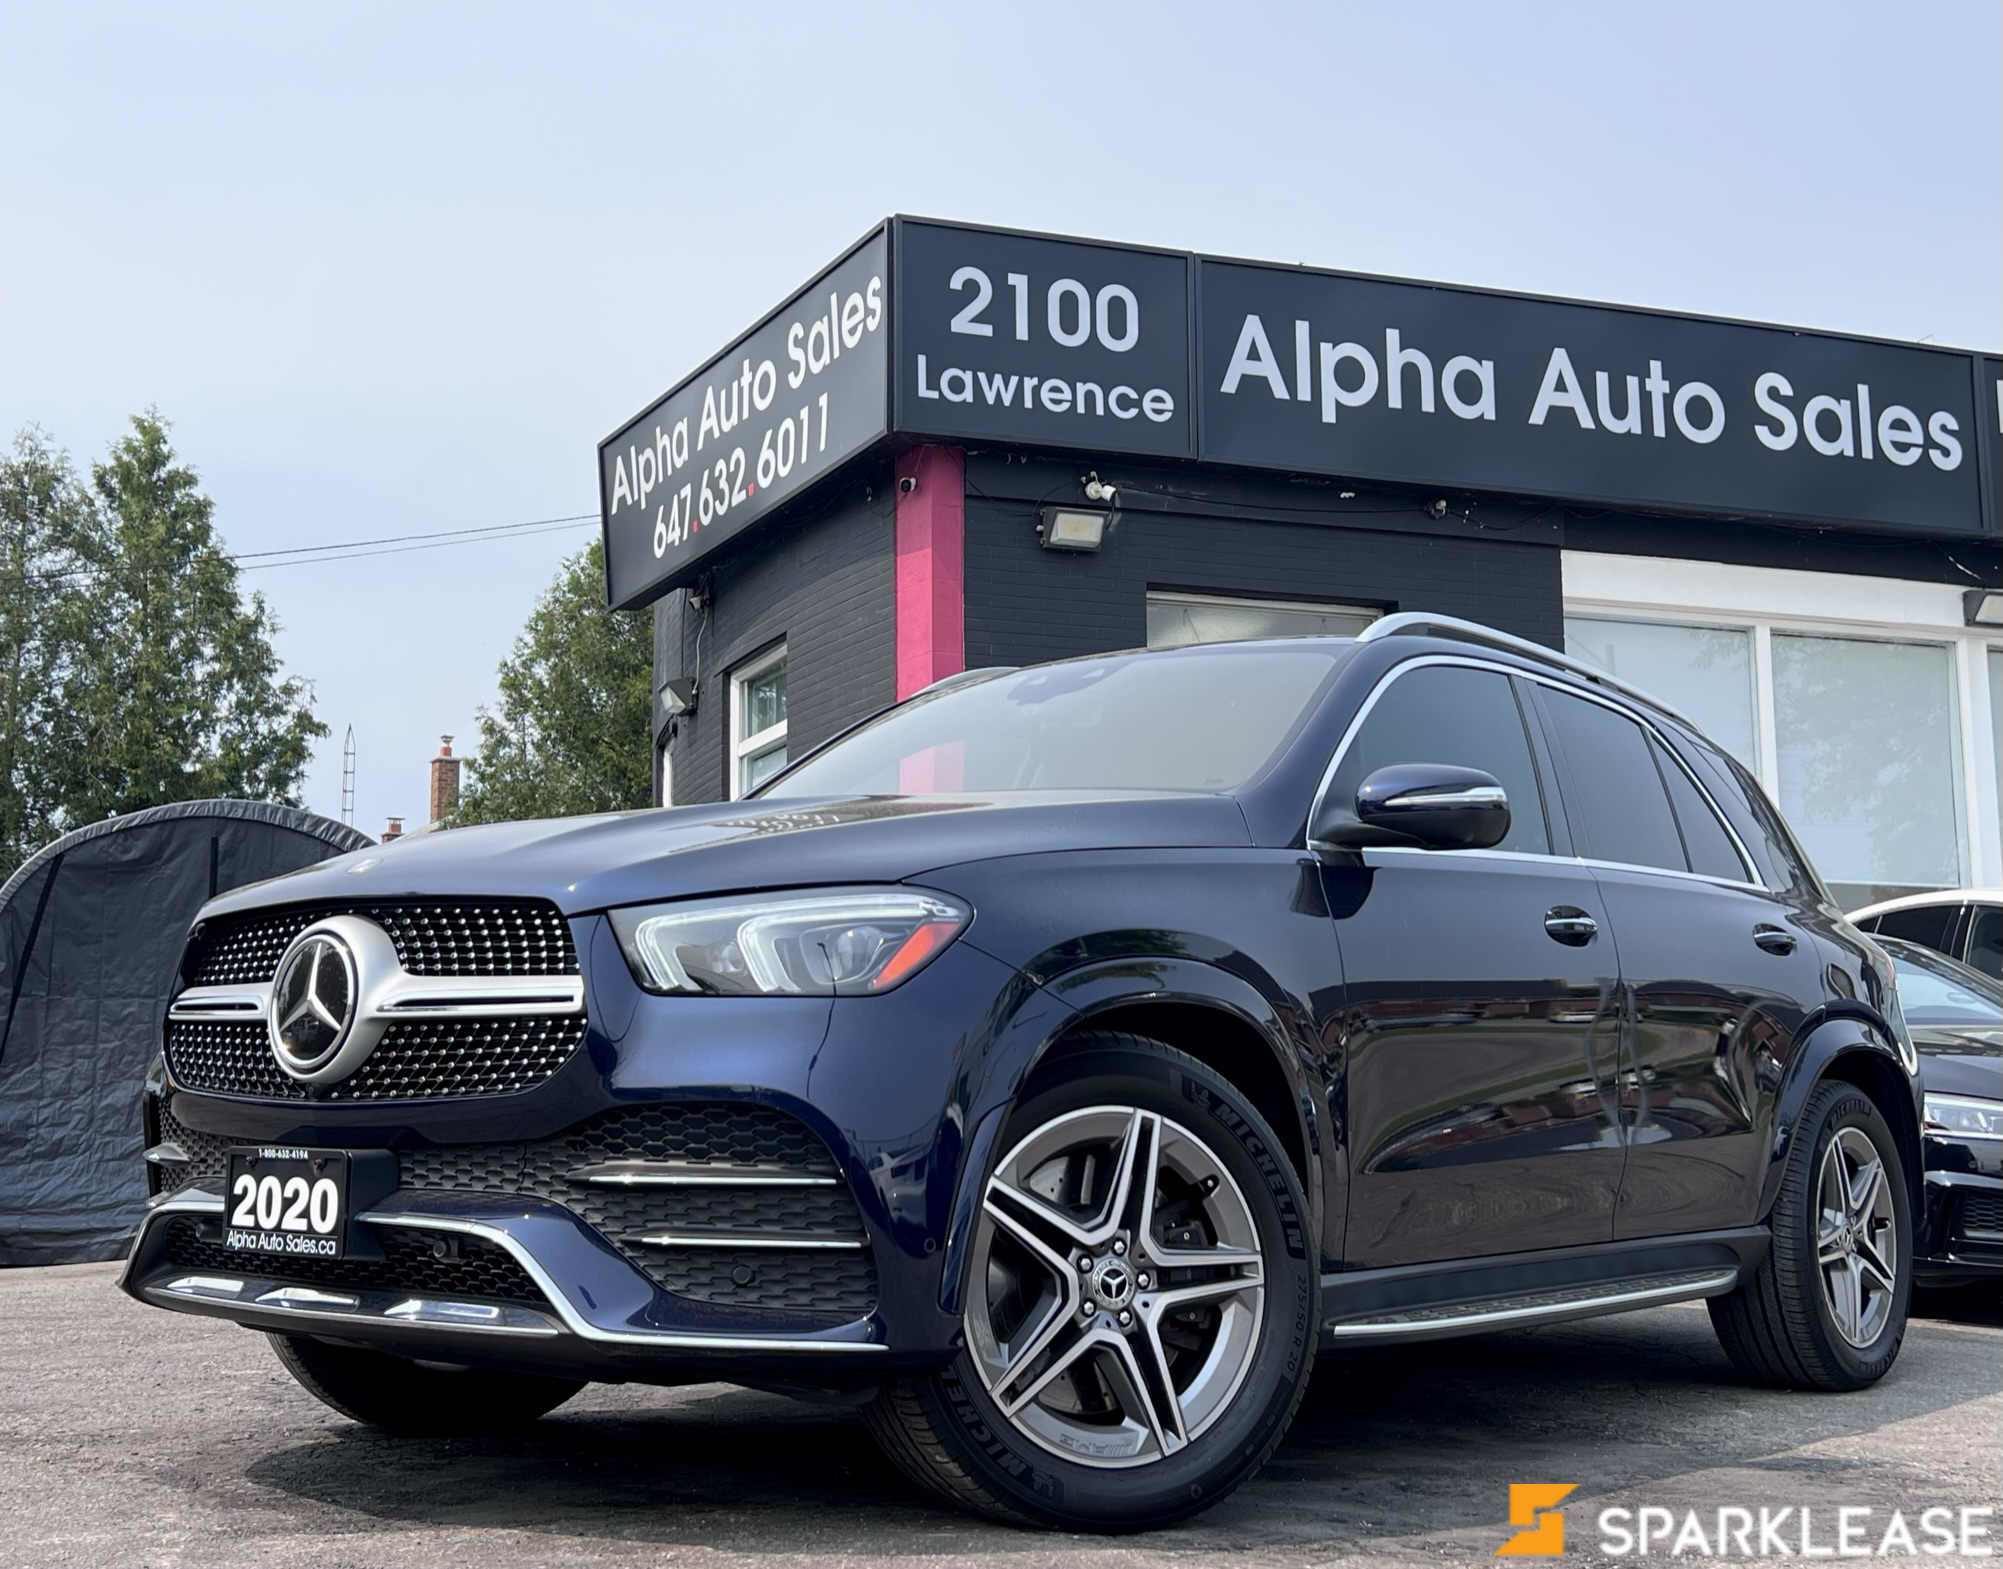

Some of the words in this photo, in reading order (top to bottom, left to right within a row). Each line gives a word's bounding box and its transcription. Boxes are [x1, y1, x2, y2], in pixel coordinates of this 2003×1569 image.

[949, 266, 1138, 352] 2100
[611, 417, 689, 516] Alpha
[697, 357, 777, 452] Auto
[787, 275, 882, 390] Sales
[917, 354, 1175, 424] Lawrence
[1220, 314, 1497, 424] Alpha
[1528, 347, 1726, 444] Auto
[1754, 371, 1963, 471] Sales
[653, 392, 829, 559] 647.632.6011
[231, 1174, 339, 1234] 2020
[1214, 1102, 1305, 1249] MICHELIN
[227, 1230, 257, 1251] Alpha
[258, 1232, 284, 1251] Auto
[286, 1234, 337, 1255] Sales.ca
